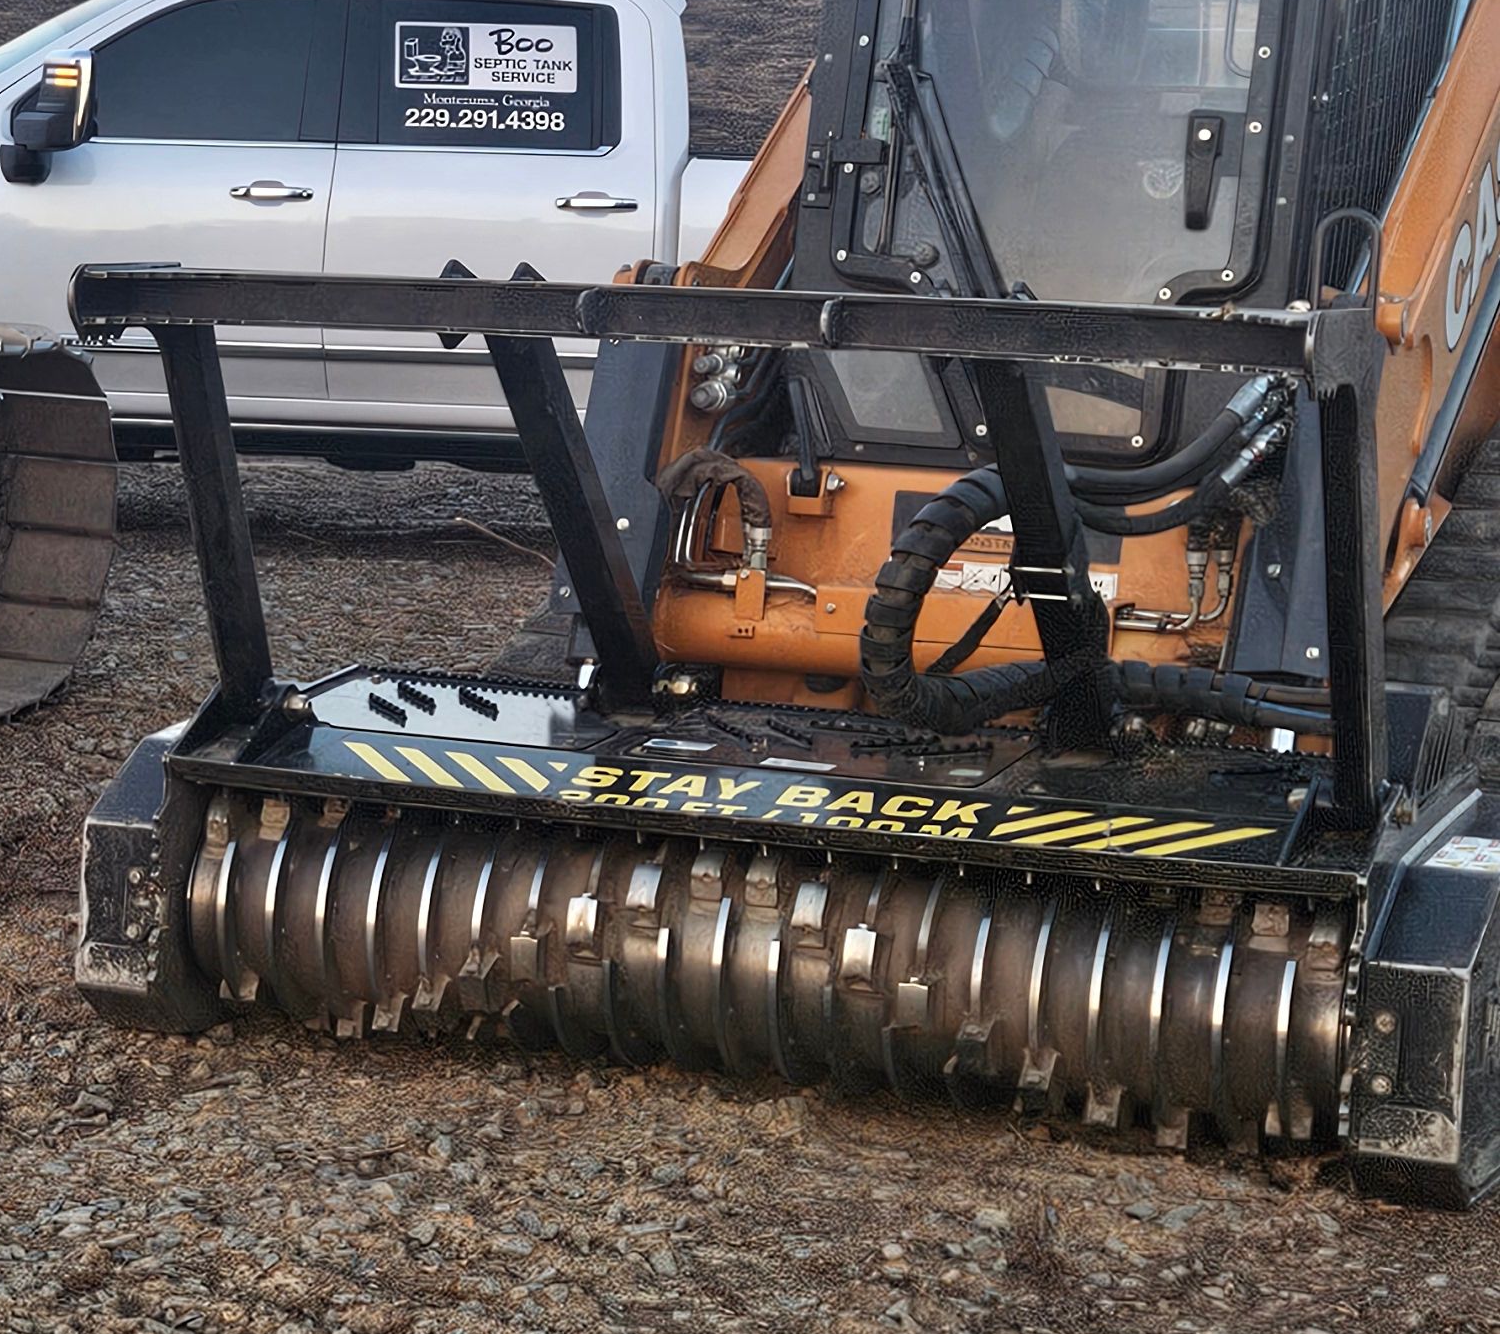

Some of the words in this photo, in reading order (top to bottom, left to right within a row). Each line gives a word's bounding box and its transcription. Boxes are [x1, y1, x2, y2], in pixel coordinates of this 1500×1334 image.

[489, 28, 554, 56] Boo
[474, 58, 527, 70] SEPTIC
[532, 59, 573, 71] TANK
[491, 71, 556, 84] SERVICE
[502, 94, 550, 109] Georgia
[404, 108, 566, 131] 229.291.4398
[1445, 137, 1500, 353] CA
[571, 766, 762, 800] STAY
[775, 785, 992, 824] BACK
